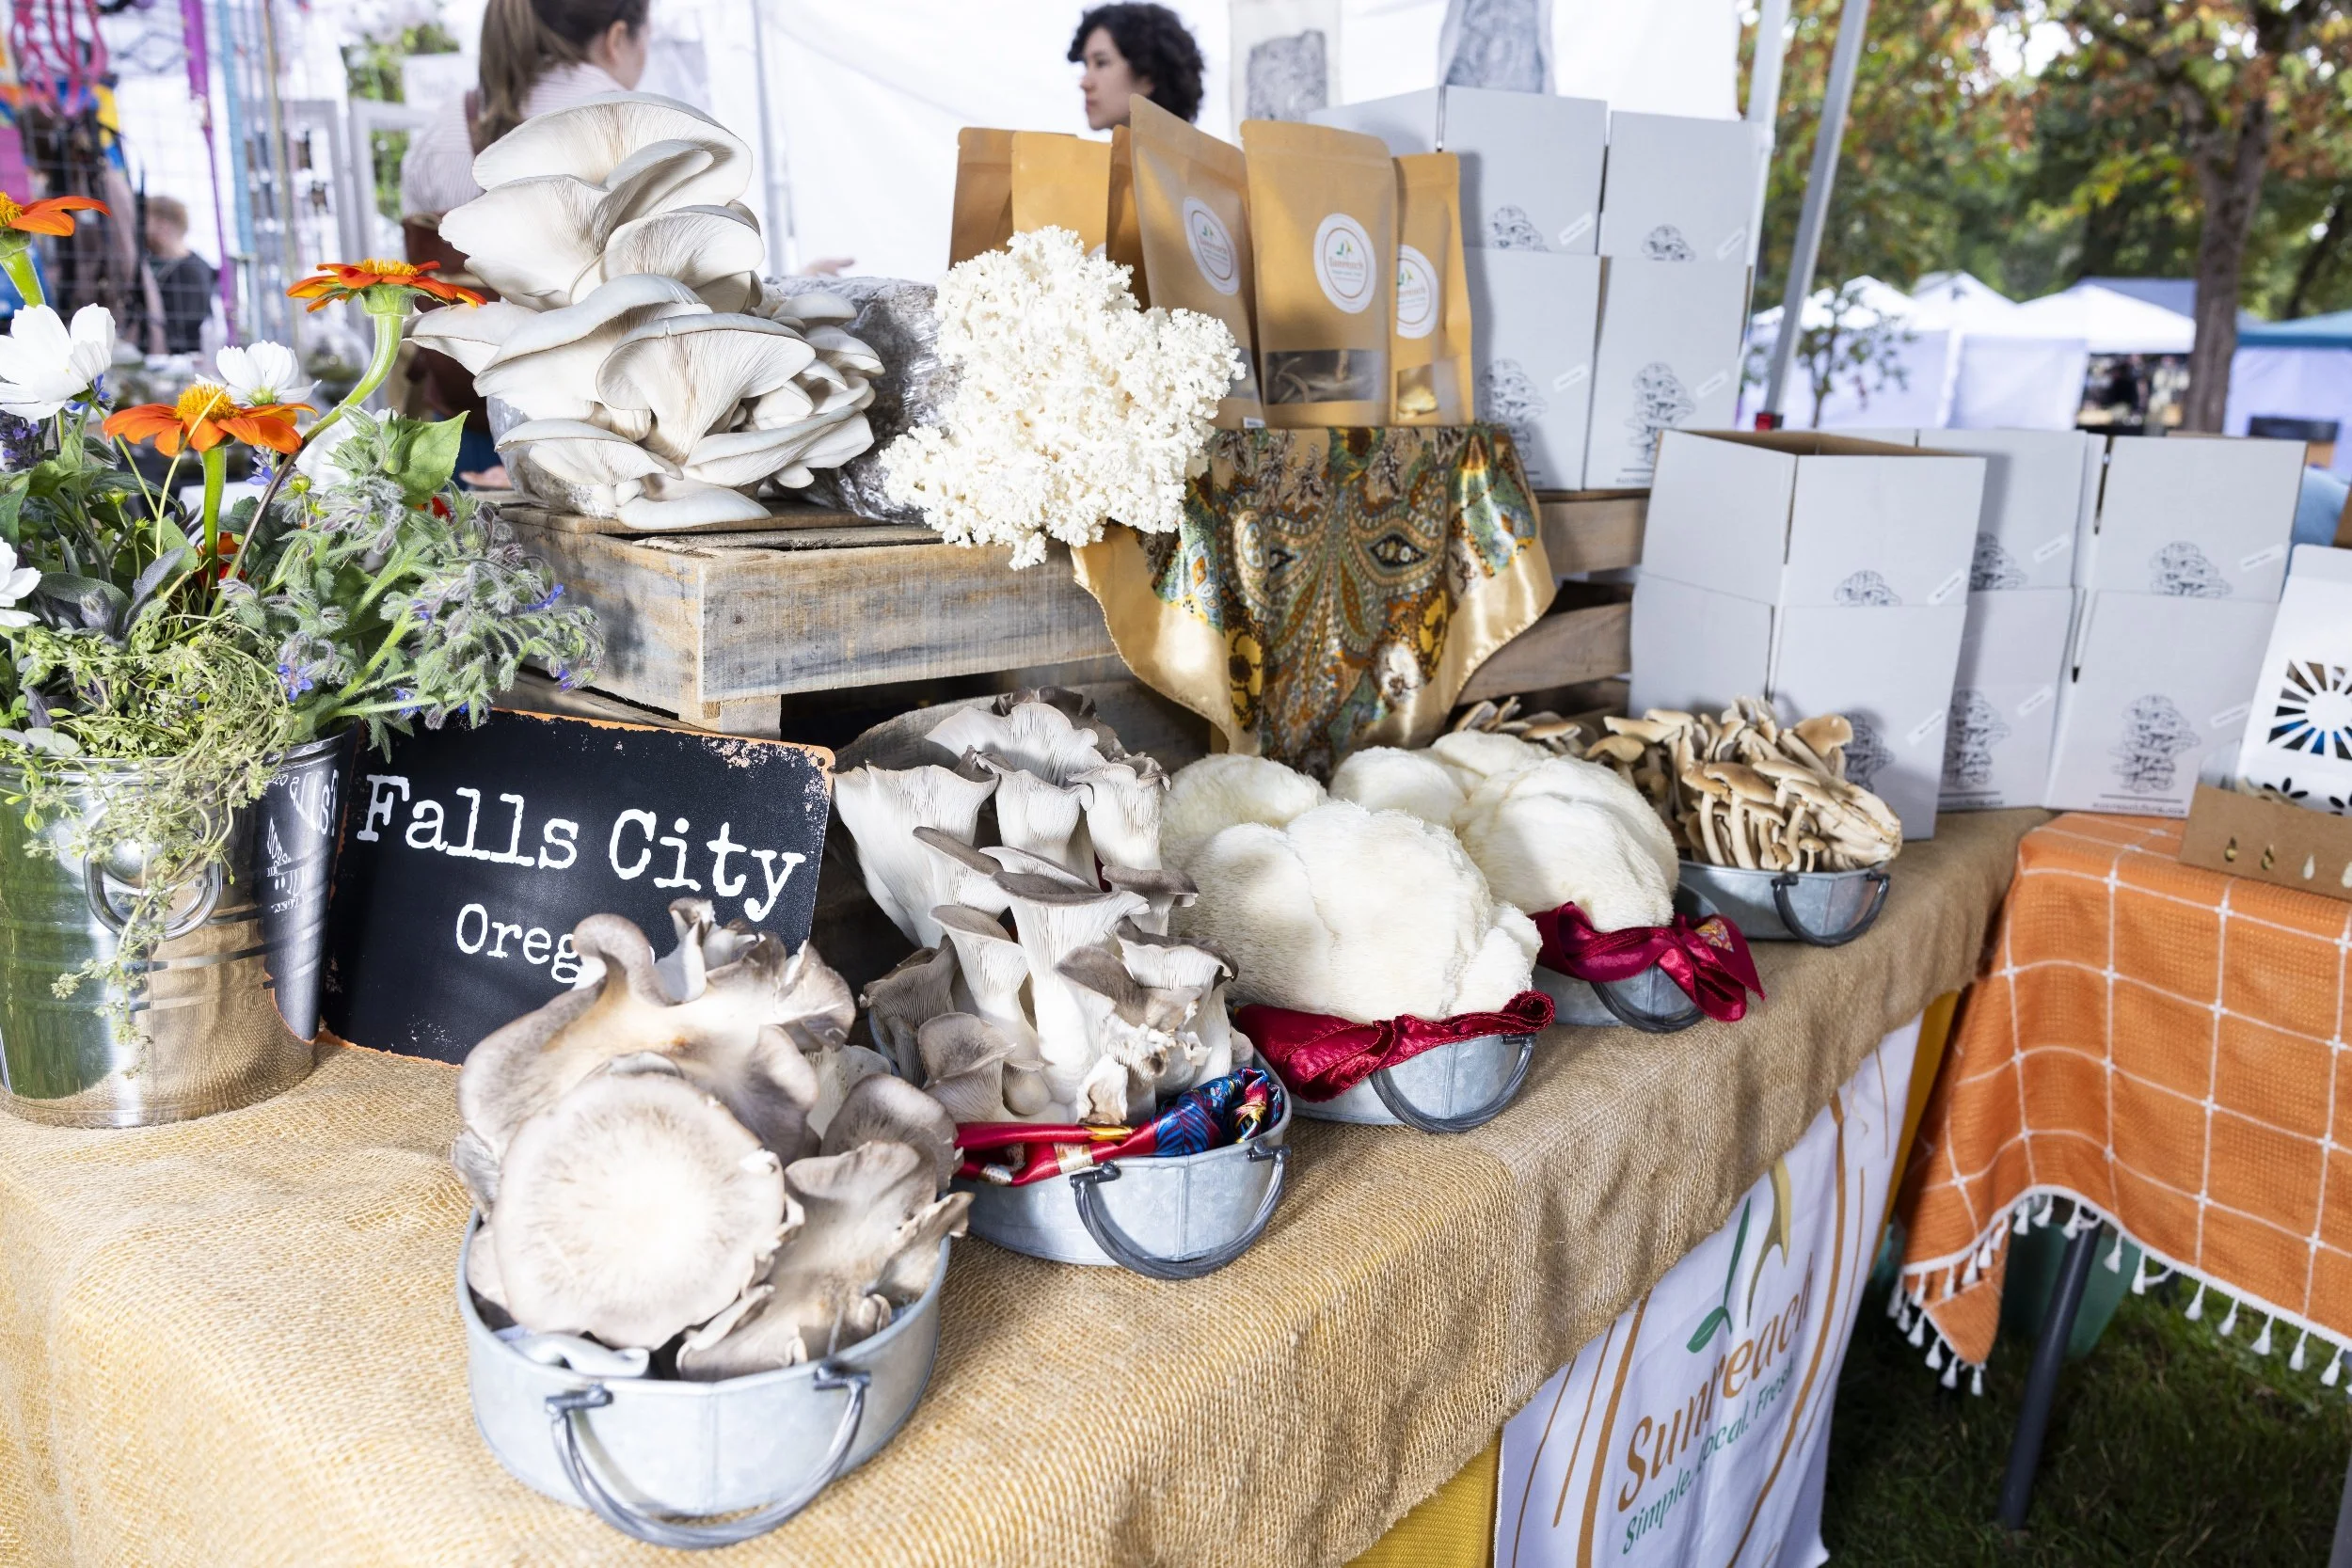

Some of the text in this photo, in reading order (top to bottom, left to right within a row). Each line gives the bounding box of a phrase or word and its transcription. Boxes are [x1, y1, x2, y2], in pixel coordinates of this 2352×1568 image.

[357, 773, 580, 869] Falls
[608, 808, 806, 922] City
[455, 903, 655, 983] Oreg
[1617, 1252, 1813, 1513] Sunreach
